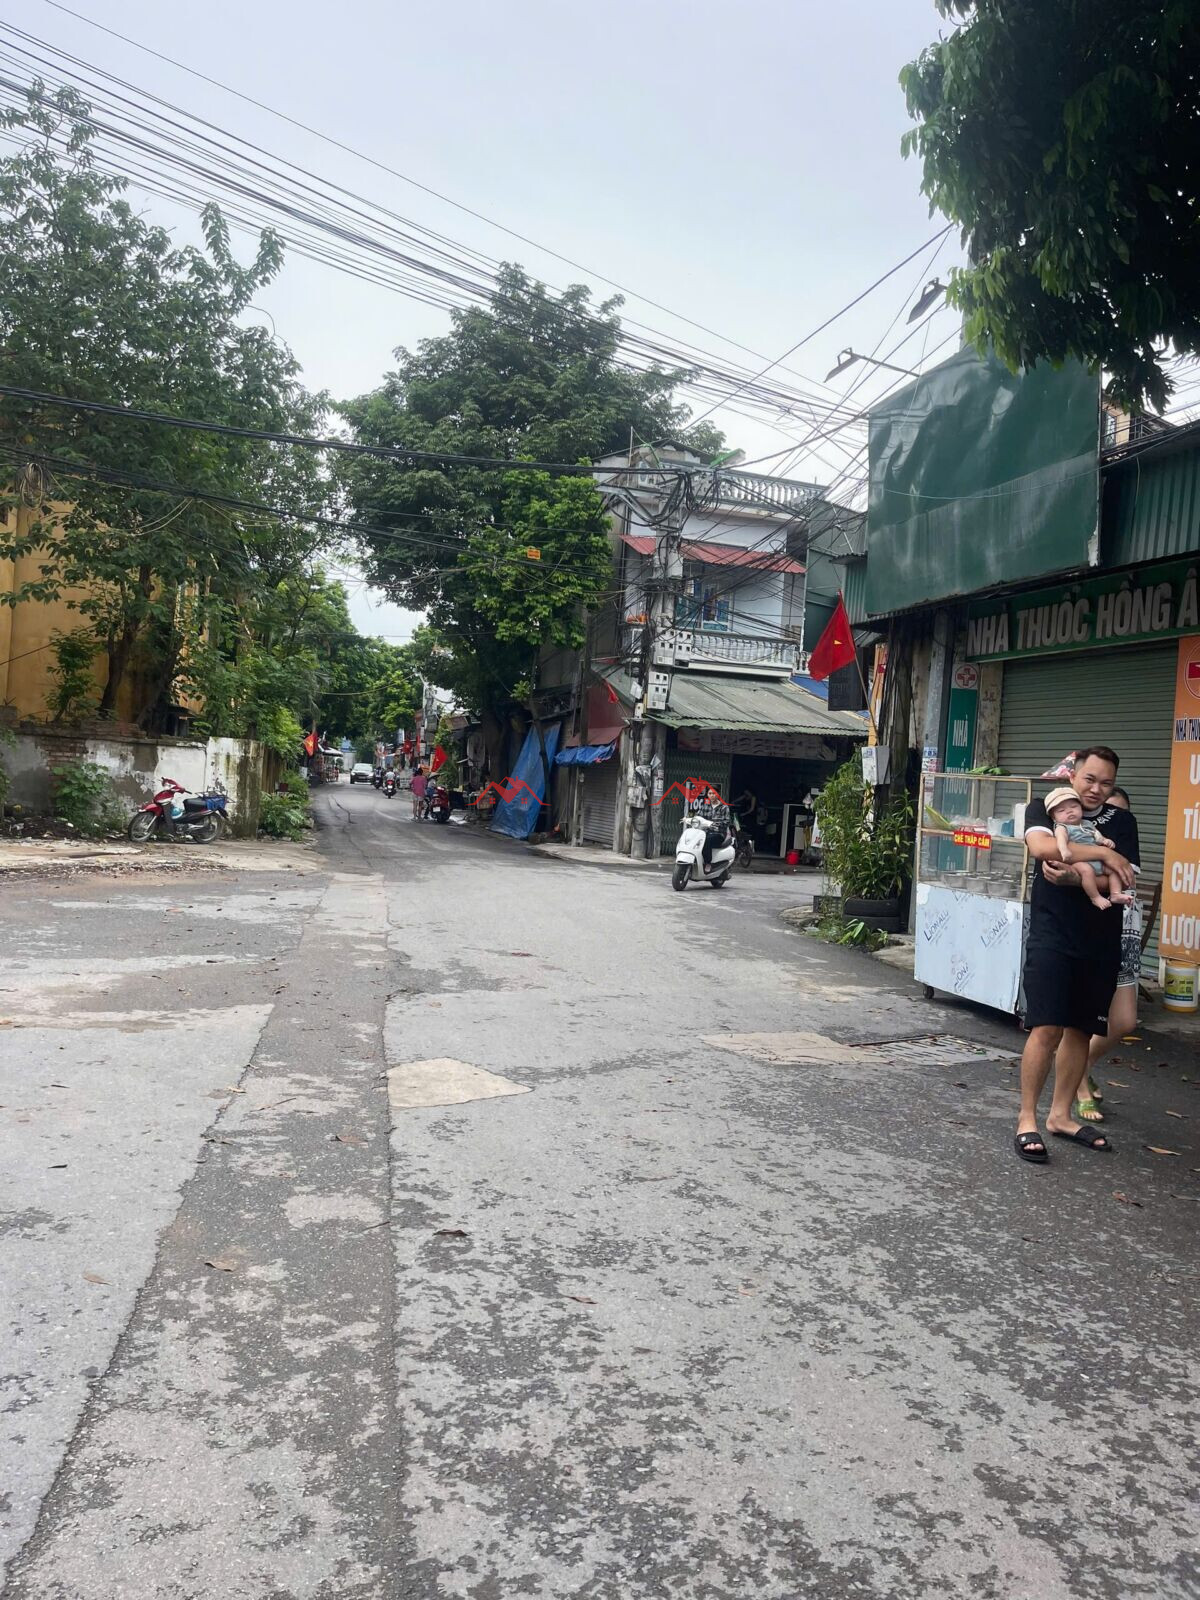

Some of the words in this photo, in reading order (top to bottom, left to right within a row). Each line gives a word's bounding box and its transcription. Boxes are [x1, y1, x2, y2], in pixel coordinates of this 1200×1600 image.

[967, 602, 1009, 657] NHÀ
[1016, 585, 1090, 650] THUỐC
[1096, 573, 1172, 639] HỒNG
[953, 712, 969, 747] NHÀ
